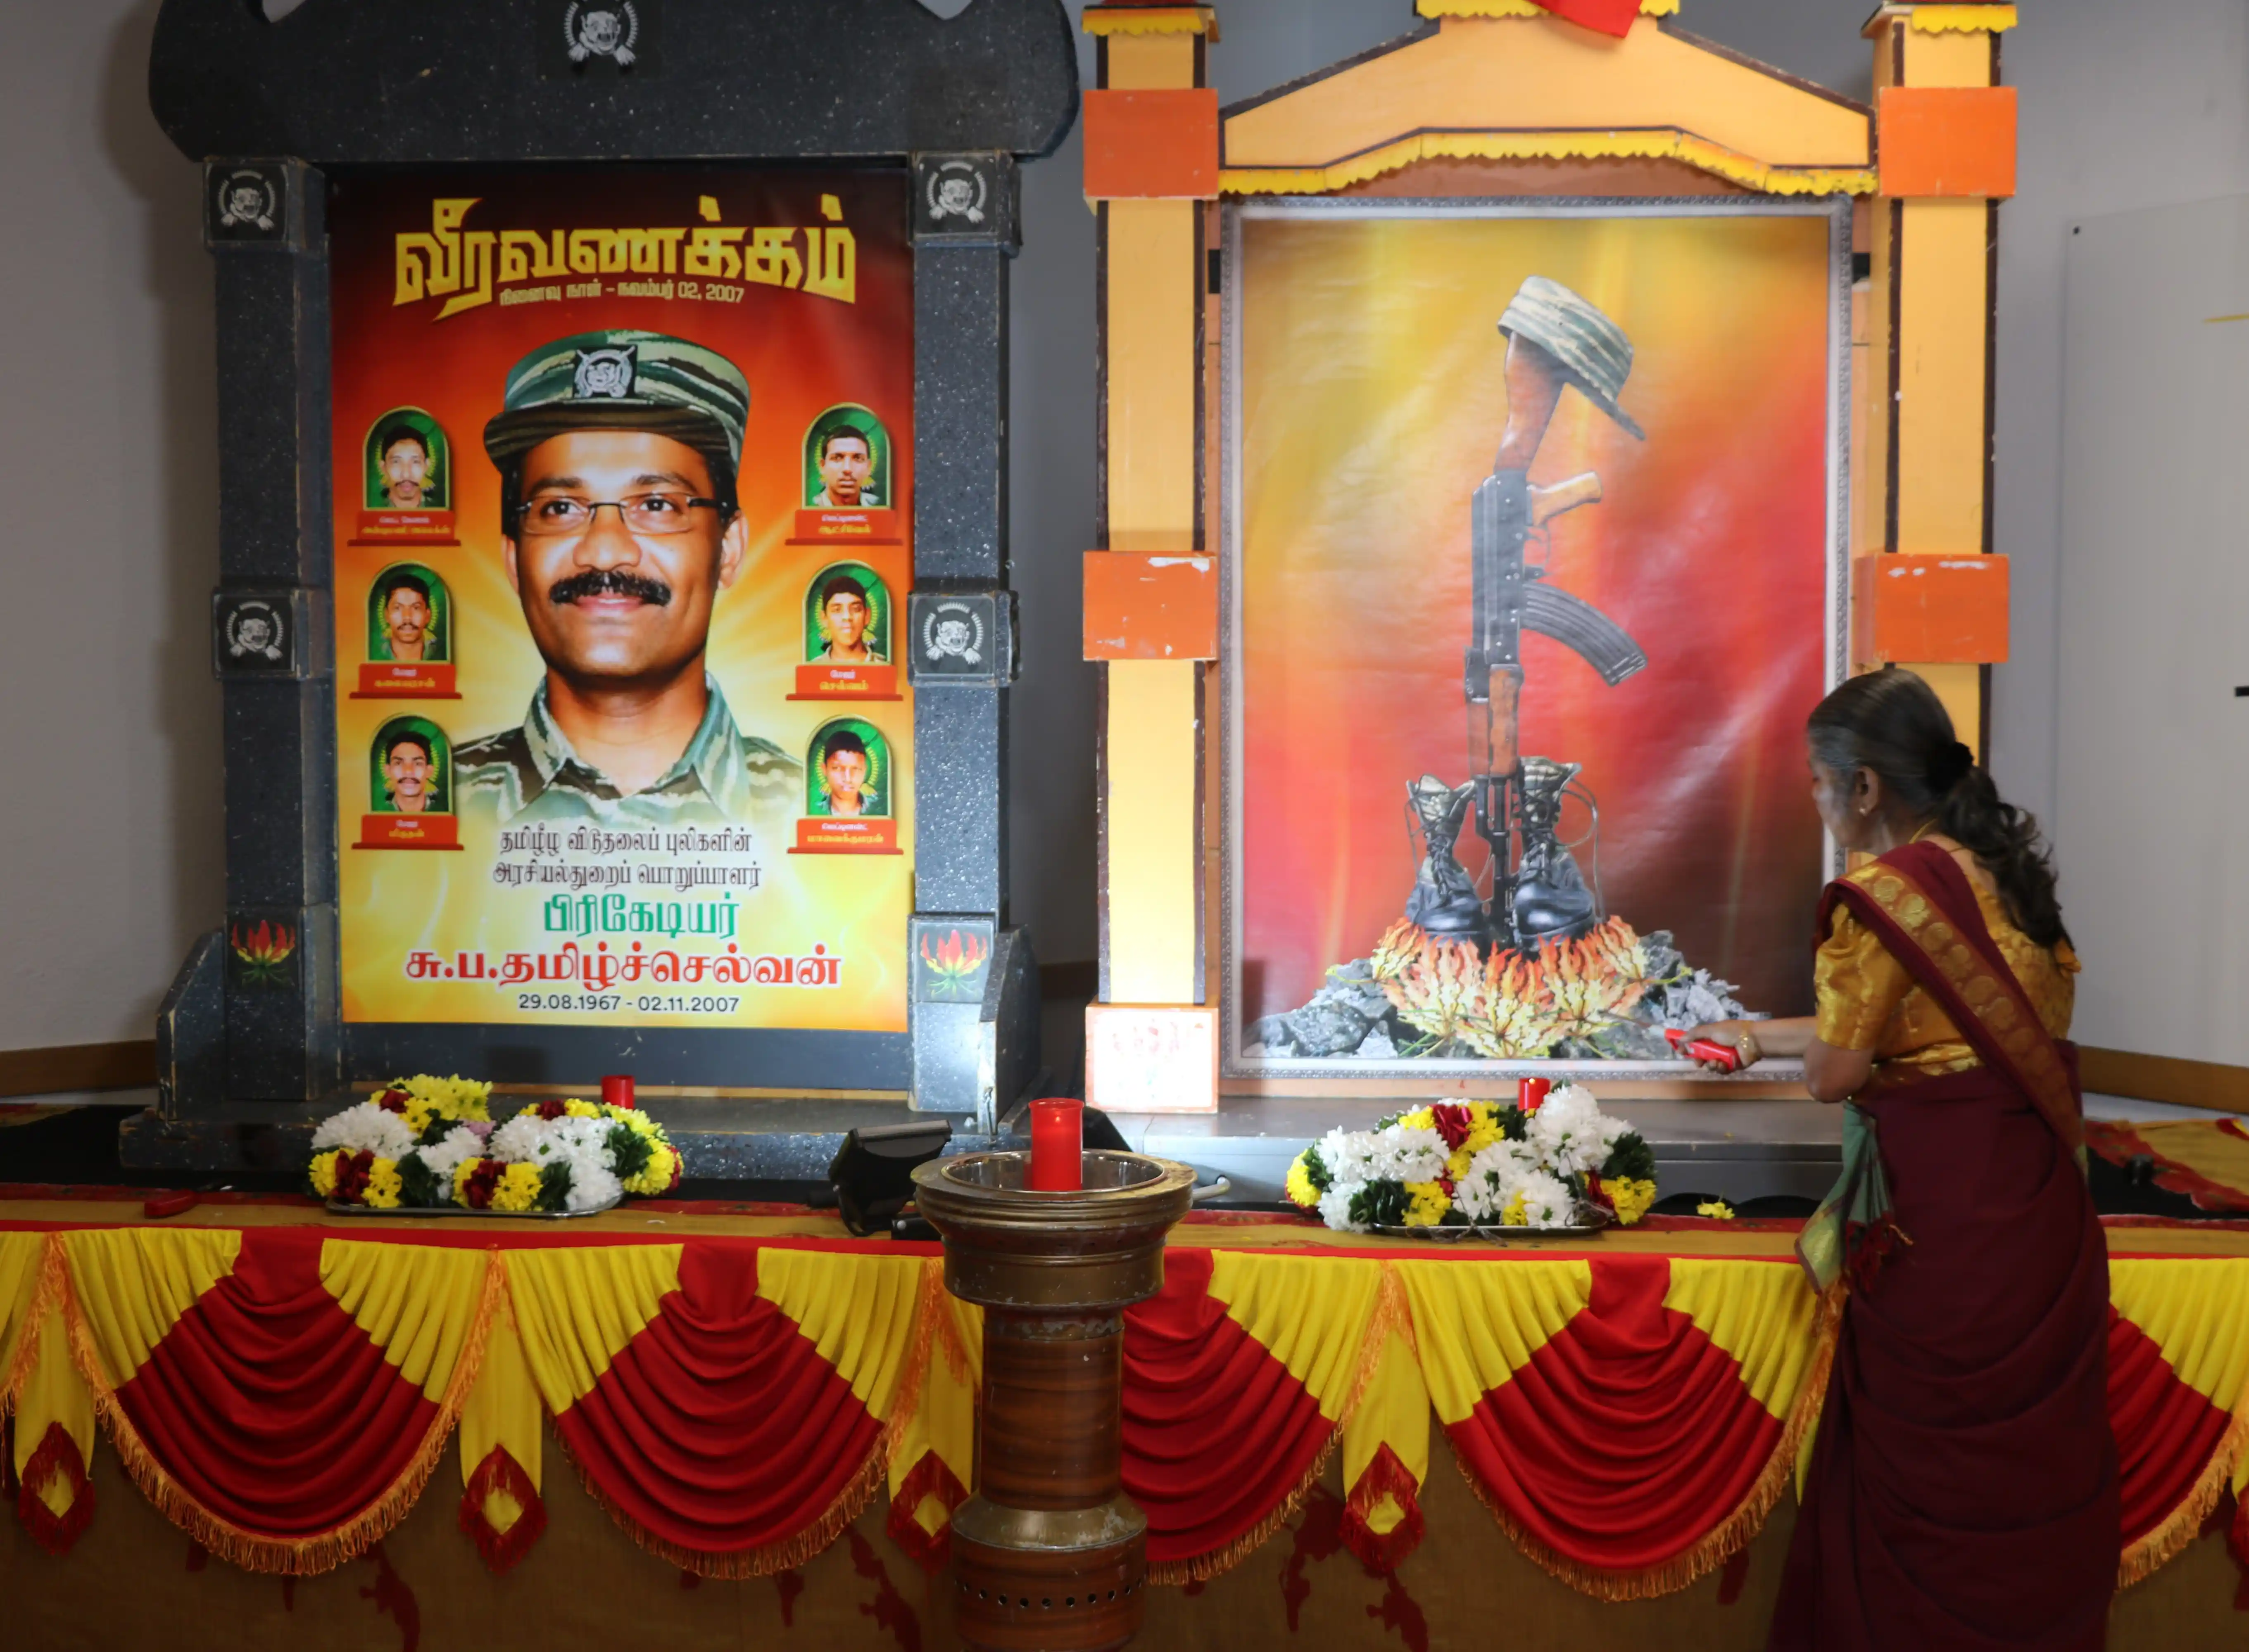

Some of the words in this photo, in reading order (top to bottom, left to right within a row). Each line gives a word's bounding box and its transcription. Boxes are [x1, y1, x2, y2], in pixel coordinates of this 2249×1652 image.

[393, 194, 856, 318] வீரவணக்கம்
[678, 281, 702, 300] 02,
[706, 283, 745, 303] 2007
[500, 823, 561, 857] தமிழீழ
[567, 826, 660, 856] விடுதலைப்
[666, 826, 753, 856] புலிகளின்
[493, 858, 632, 891] அரசியல்துறைப்
[637, 860, 762, 893] பொறுப்பாளர்
[544, 890, 741, 940] பிரிகேடியர்
[519, 994, 621, 1010] 29.08.1967
[638, 996, 739, 1012] 02.11.2007
